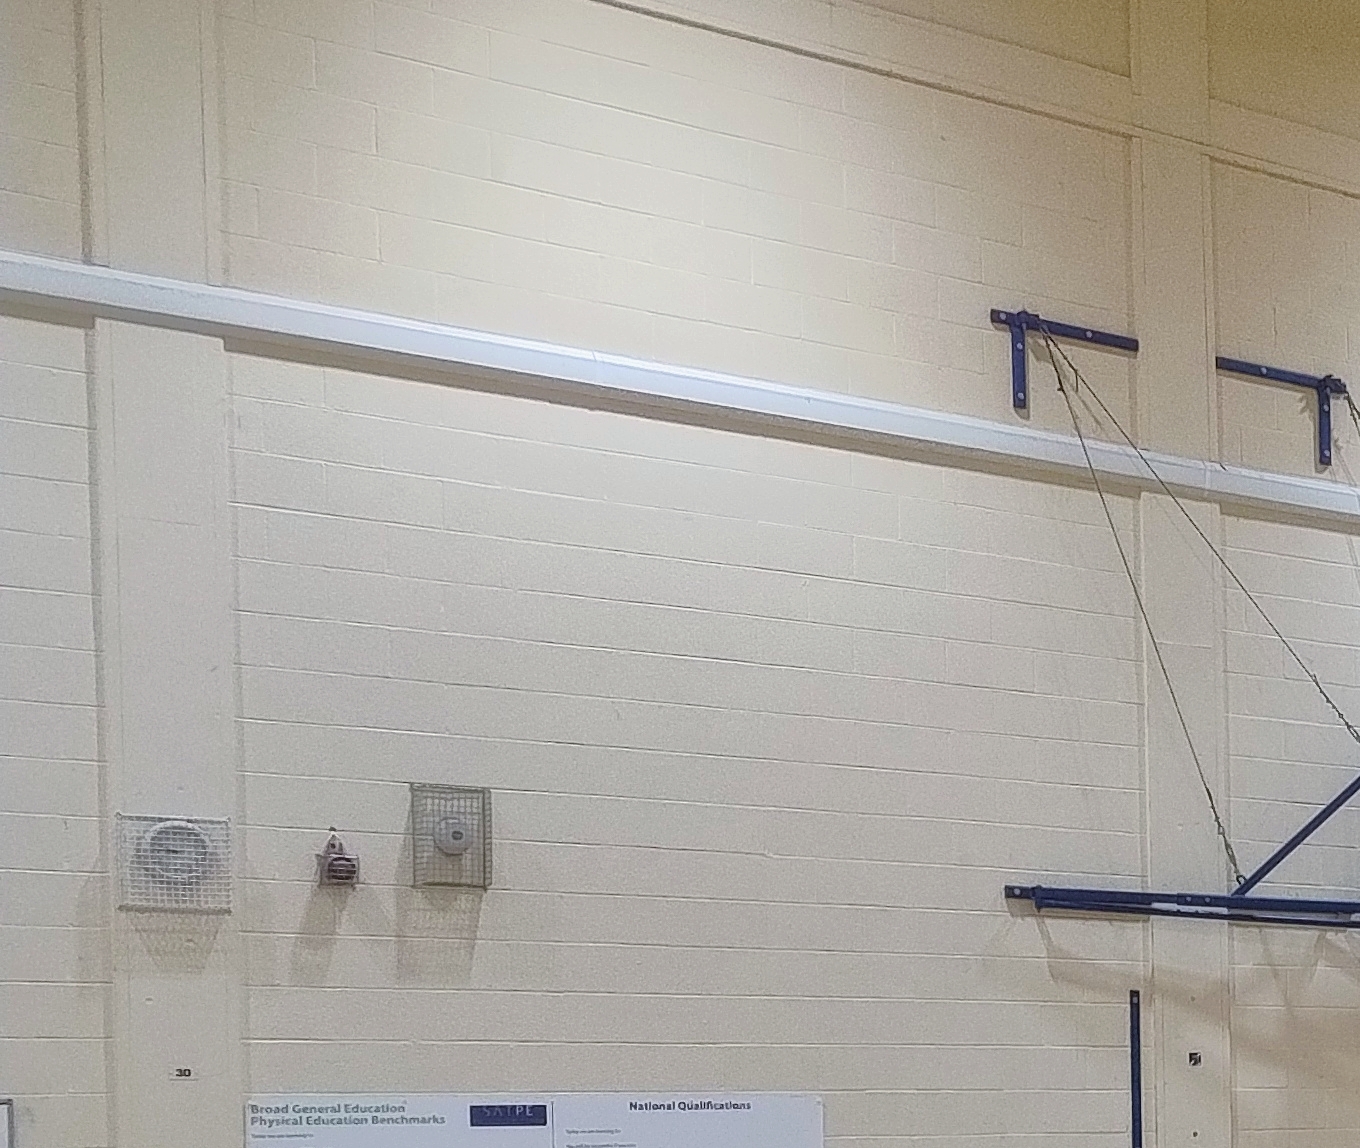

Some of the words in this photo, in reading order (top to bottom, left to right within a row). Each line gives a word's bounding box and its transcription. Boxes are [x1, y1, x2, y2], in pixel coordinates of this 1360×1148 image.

[250, 1104, 289, 1114] Broad
[291, 1103, 341, 1114] General
[343, 1102, 405, 1114] Education
[629, 1101, 675, 1111] National
[678, 1100, 751, 1111] Qualifications
[250, 1116, 303, 1128] Physical
[306, 1115, 368, 1126] Education
[371, 1115, 446, 1125] Benchmarks
